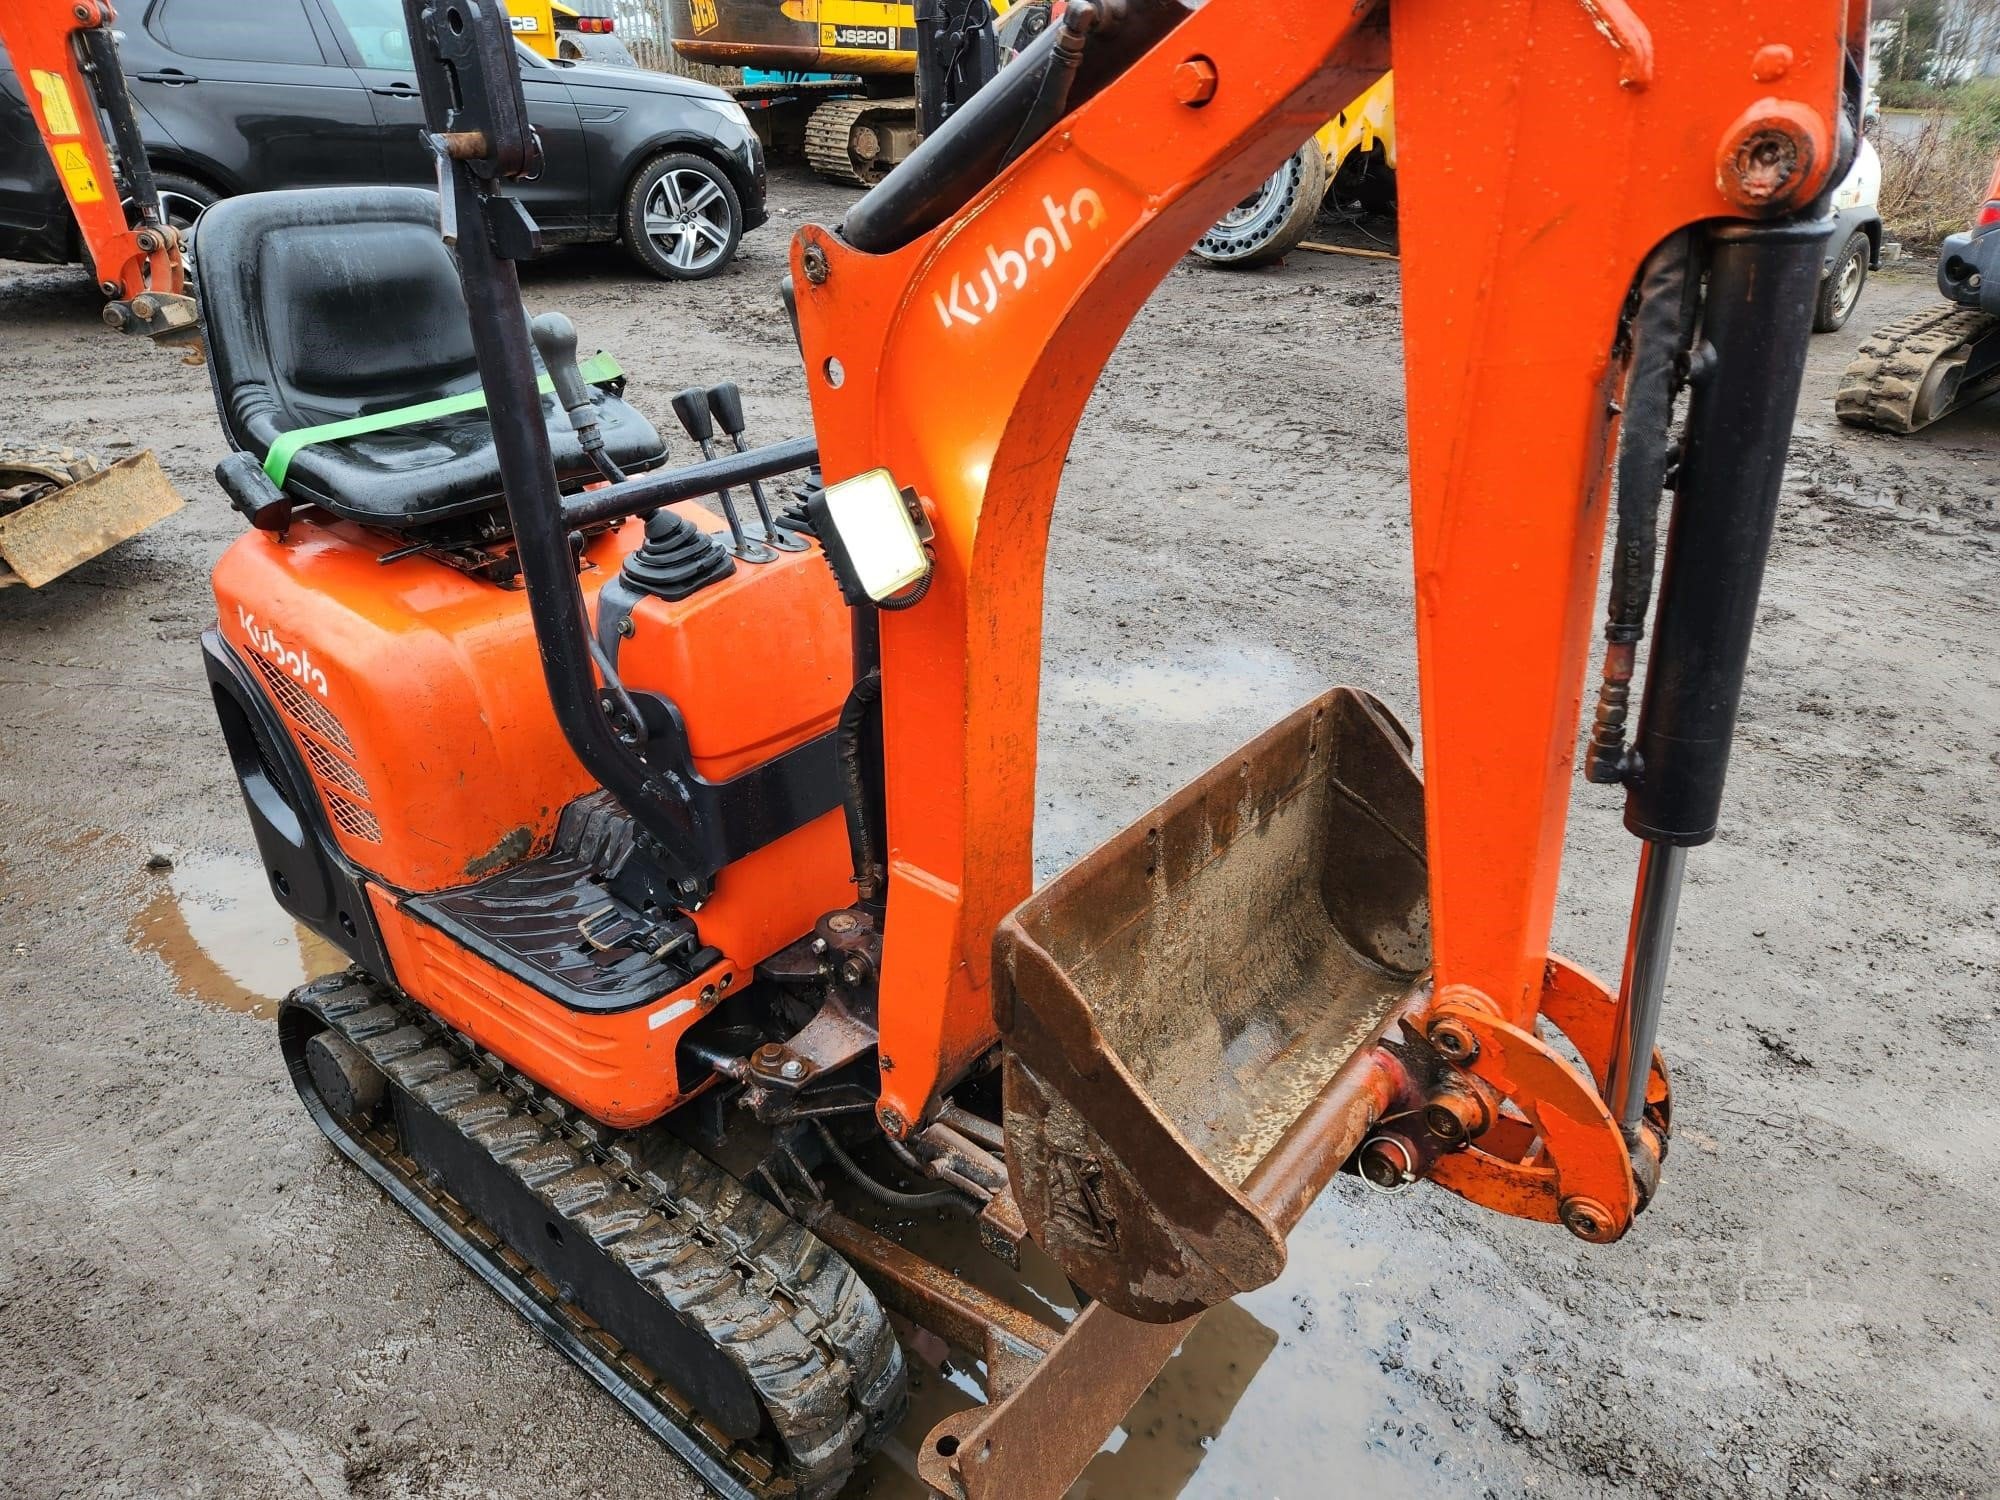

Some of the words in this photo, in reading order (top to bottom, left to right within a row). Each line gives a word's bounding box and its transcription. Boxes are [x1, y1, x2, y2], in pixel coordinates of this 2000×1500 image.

[509, 16, 538, 31] CB
[836, 29, 887, 44] JS220
[931, 187, 1109, 329] Kubota
[238, 604, 328, 697] Kubota
